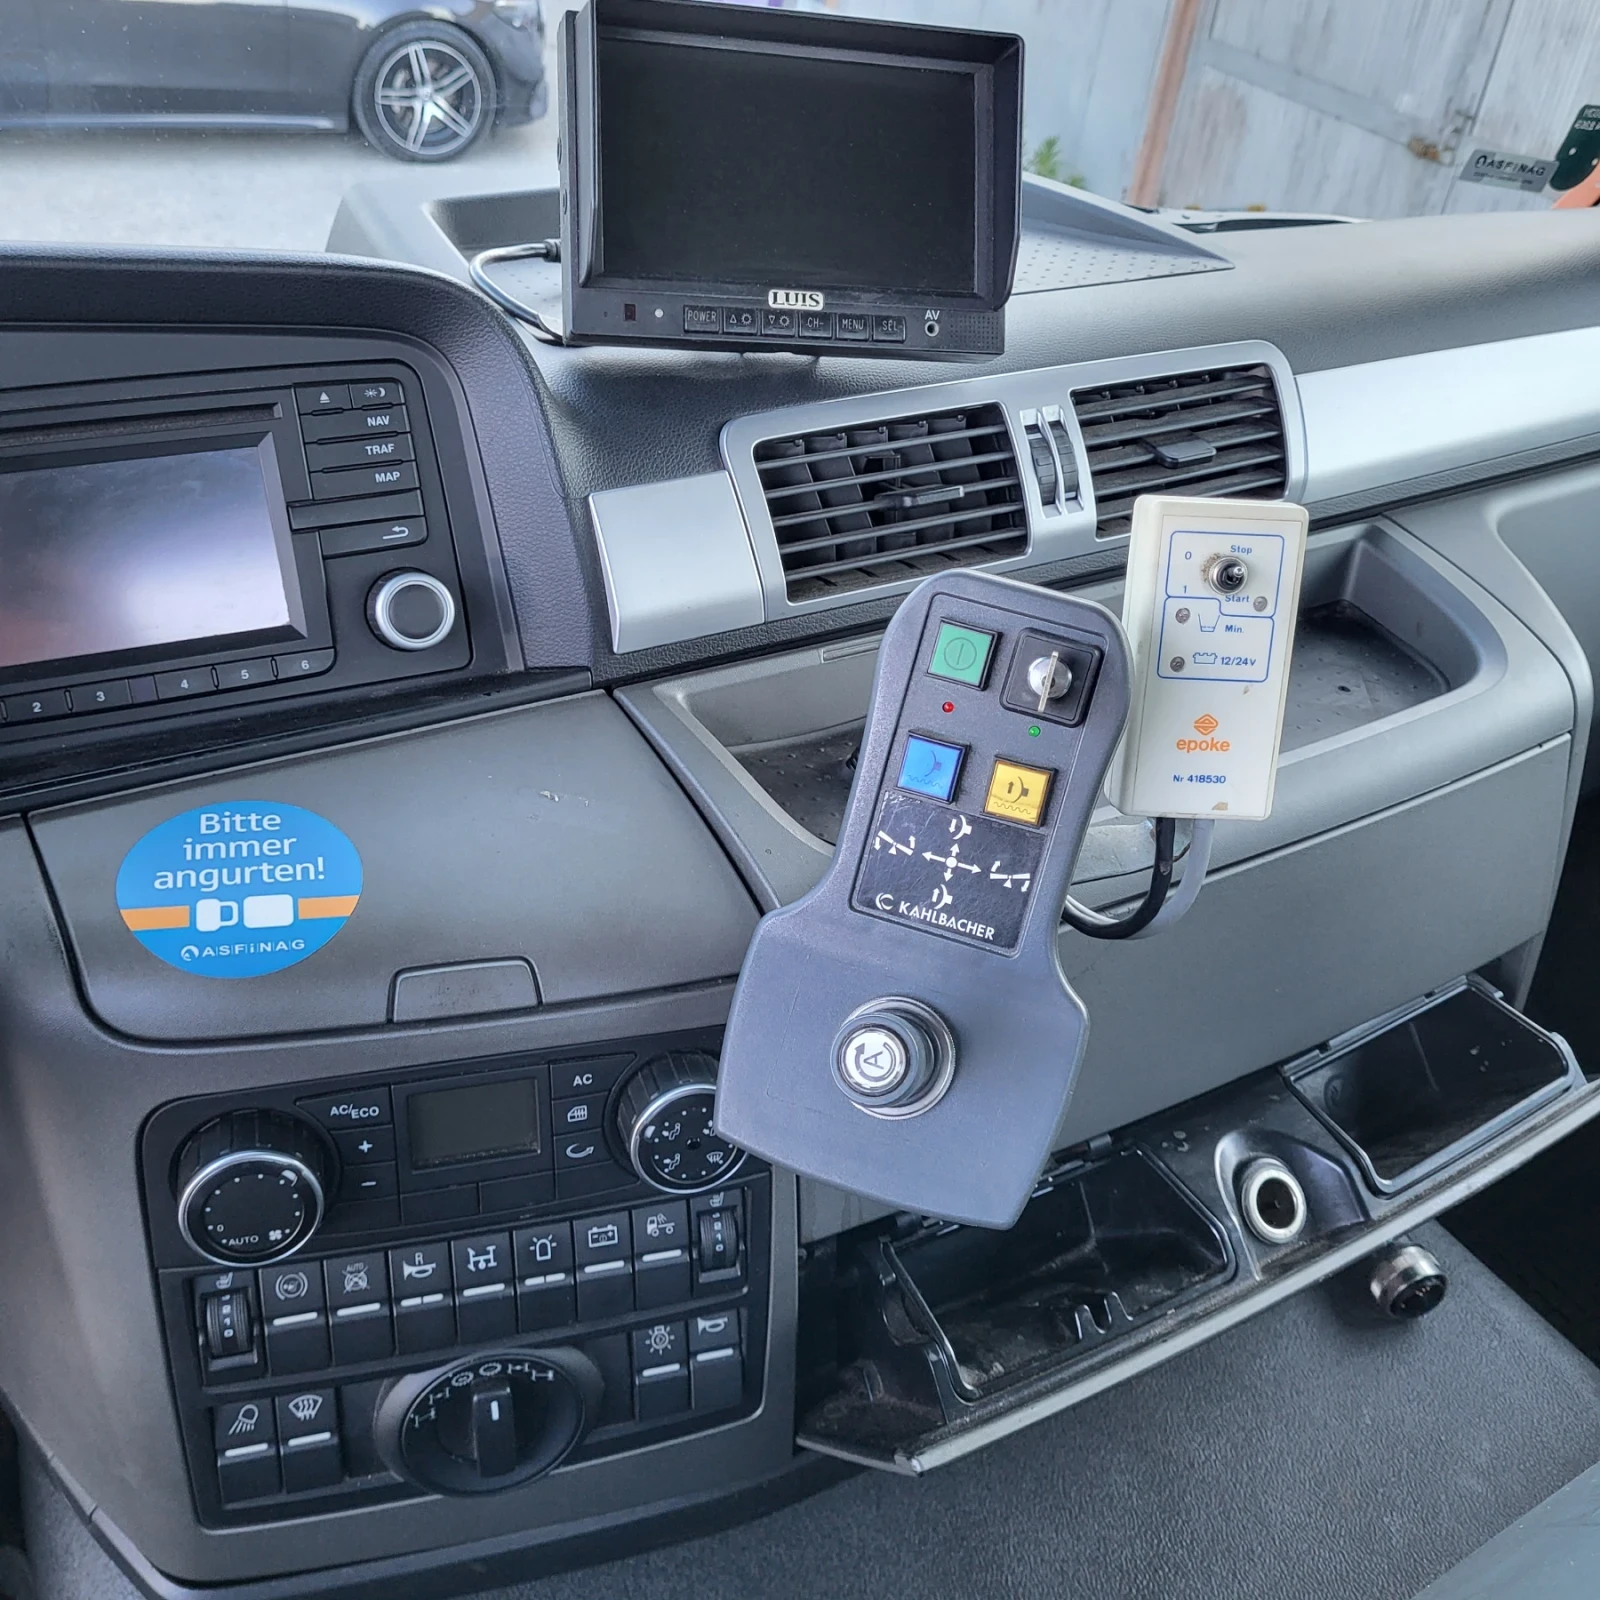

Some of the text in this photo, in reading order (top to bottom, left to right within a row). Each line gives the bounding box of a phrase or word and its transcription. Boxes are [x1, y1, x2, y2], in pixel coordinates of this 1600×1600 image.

[772, 291, 820, 307] LUIS
[687, 310, 717, 322] POWER
[925, 310, 940, 320] AV
[842, 319, 864, 330] MENU
[367, 415, 390, 427] NAV
[365, 443, 395, 456] TRAF
[375, 471, 401, 483] MAP
[1230, 544, 1253, 555] Stop
[1224, 594, 1250, 603] Start
[301, 660, 310, 670] 6
[240, 669, 250, 680] 5
[180, 679, 189, 689] 4
[96, 691, 105, 702] 3
[32, 702, 42, 713] 2
[1176, 737, 1231, 753] epoke
[1173, 773, 1226, 784] Nr 418530
[200, 811, 282, 834] Bitte
[183, 837, 297, 861] immer
[153, 857, 325, 892] angurten!
[898, 900, 995, 941] KAHLBACHER
[863, 1050, 884, 1070] A
[573, 1074, 593, 1086] AC
[330, 1104, 380, 1119] AC/ECO
[216, 1224, 224, 1232] 0
[228, 1235, 259, 1246] AUTO
[414, 1252, 424, 1265] R
[346, 1262, 365, 1272] AUTO
